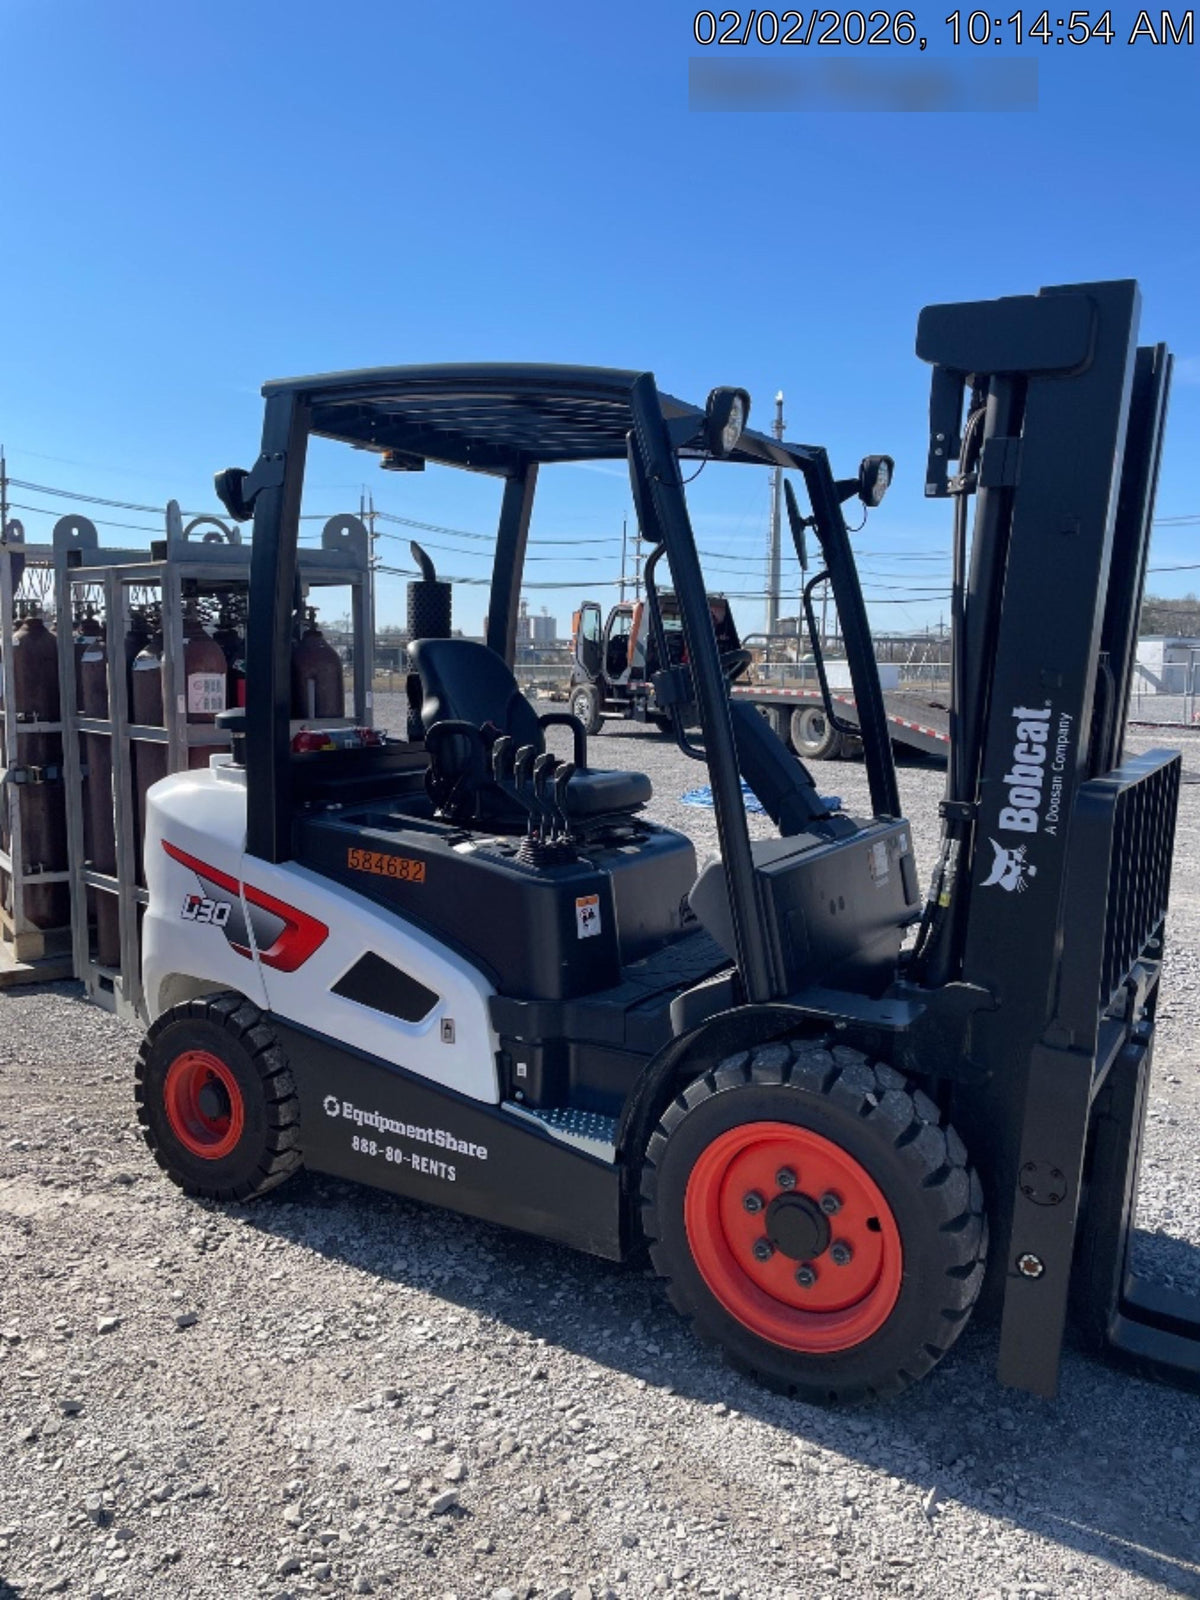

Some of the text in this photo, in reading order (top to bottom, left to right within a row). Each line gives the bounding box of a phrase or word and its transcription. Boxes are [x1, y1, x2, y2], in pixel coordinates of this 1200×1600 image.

[998, 706, 1052, 833] Bobcat
[1044, 711, 1074, 836] A Doosan Company
[349, 848, 423, 881] 584682
[180, 893, 233, 927] D30
[341, 1100, 489, 1161] EquipmentShare
[351, 1135, 457, 1182] 888-80-RENTS
